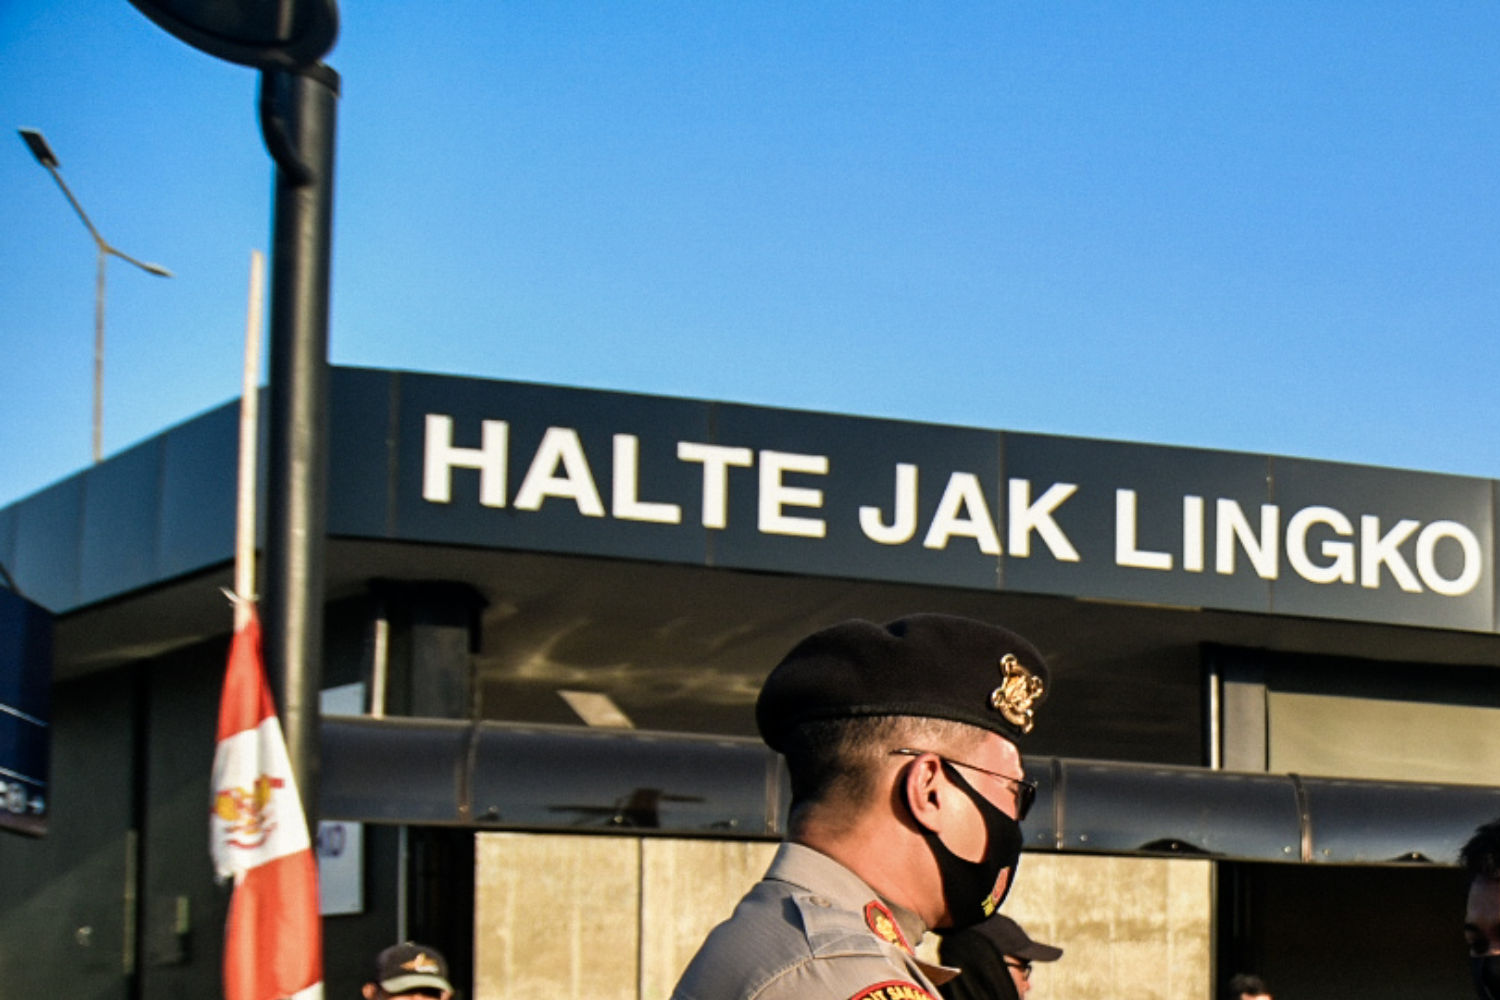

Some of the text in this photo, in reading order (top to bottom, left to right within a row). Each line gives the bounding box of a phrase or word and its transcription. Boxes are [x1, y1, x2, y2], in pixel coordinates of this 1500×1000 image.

[422, 413, 829, 538] HALTE
[858, 462, 1081, 562] JAK
[1115, 488, 1482, 596] LINGKO
